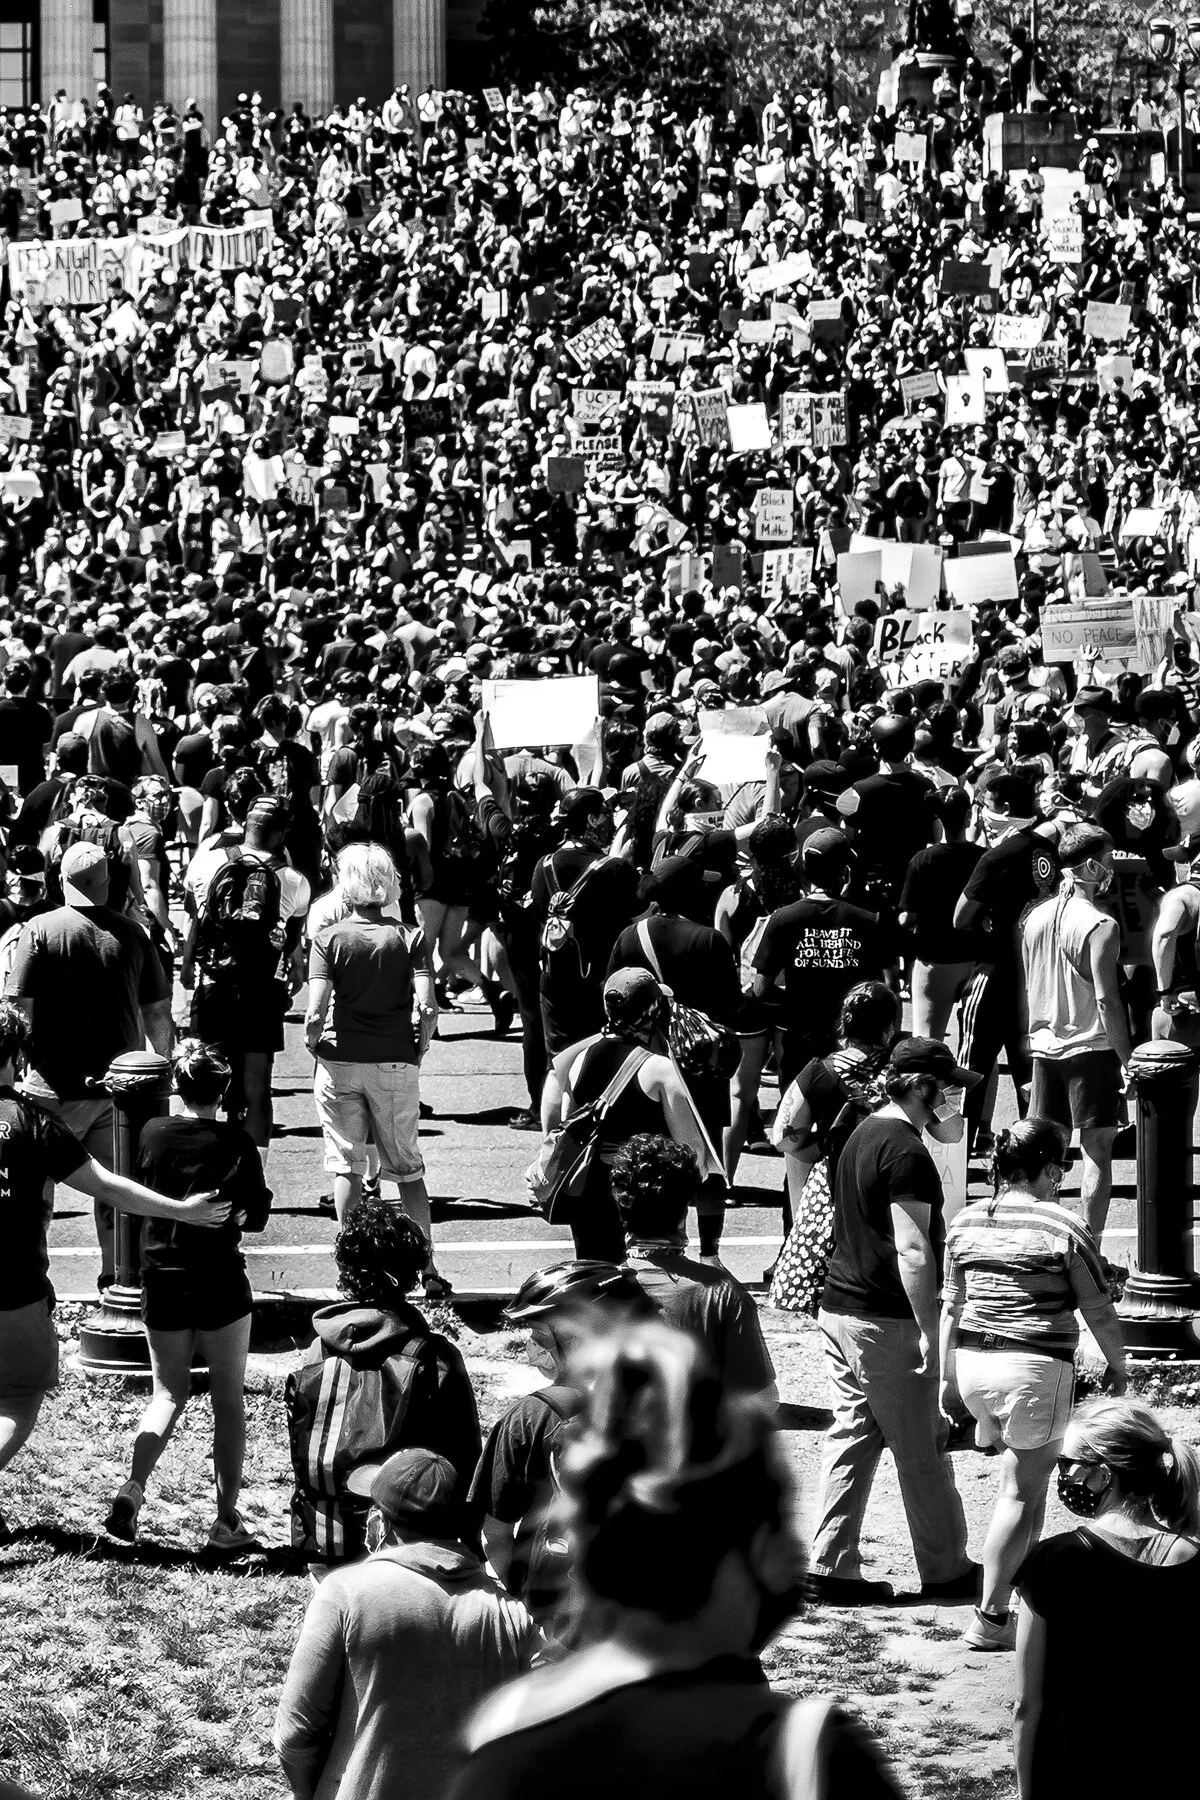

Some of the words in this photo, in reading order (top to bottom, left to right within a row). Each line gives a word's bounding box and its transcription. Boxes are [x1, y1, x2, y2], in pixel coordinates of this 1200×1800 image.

[55, 241, 98, 270] RIGHT
[66, 270, 83, 302] TO
[577, 390, 613, 404] FUCK
[575, 437, 620, 451] PLEASE
[1051, 629, 1074, 644] NO
[1083, 627, 1123, 643] PEACE
[804, 927, 839, 940] LEAVE
[840, 926, 853, 938] IT
[795, 937, 819, 950] ALL
[820, 938, 862, 950] BEHIND
[799, 948, 821, 958] FOR
[822, 949, 831, 958] A
[794, 957, 810, 968] OF
[811, 958, 860, 969] SUNDYS
